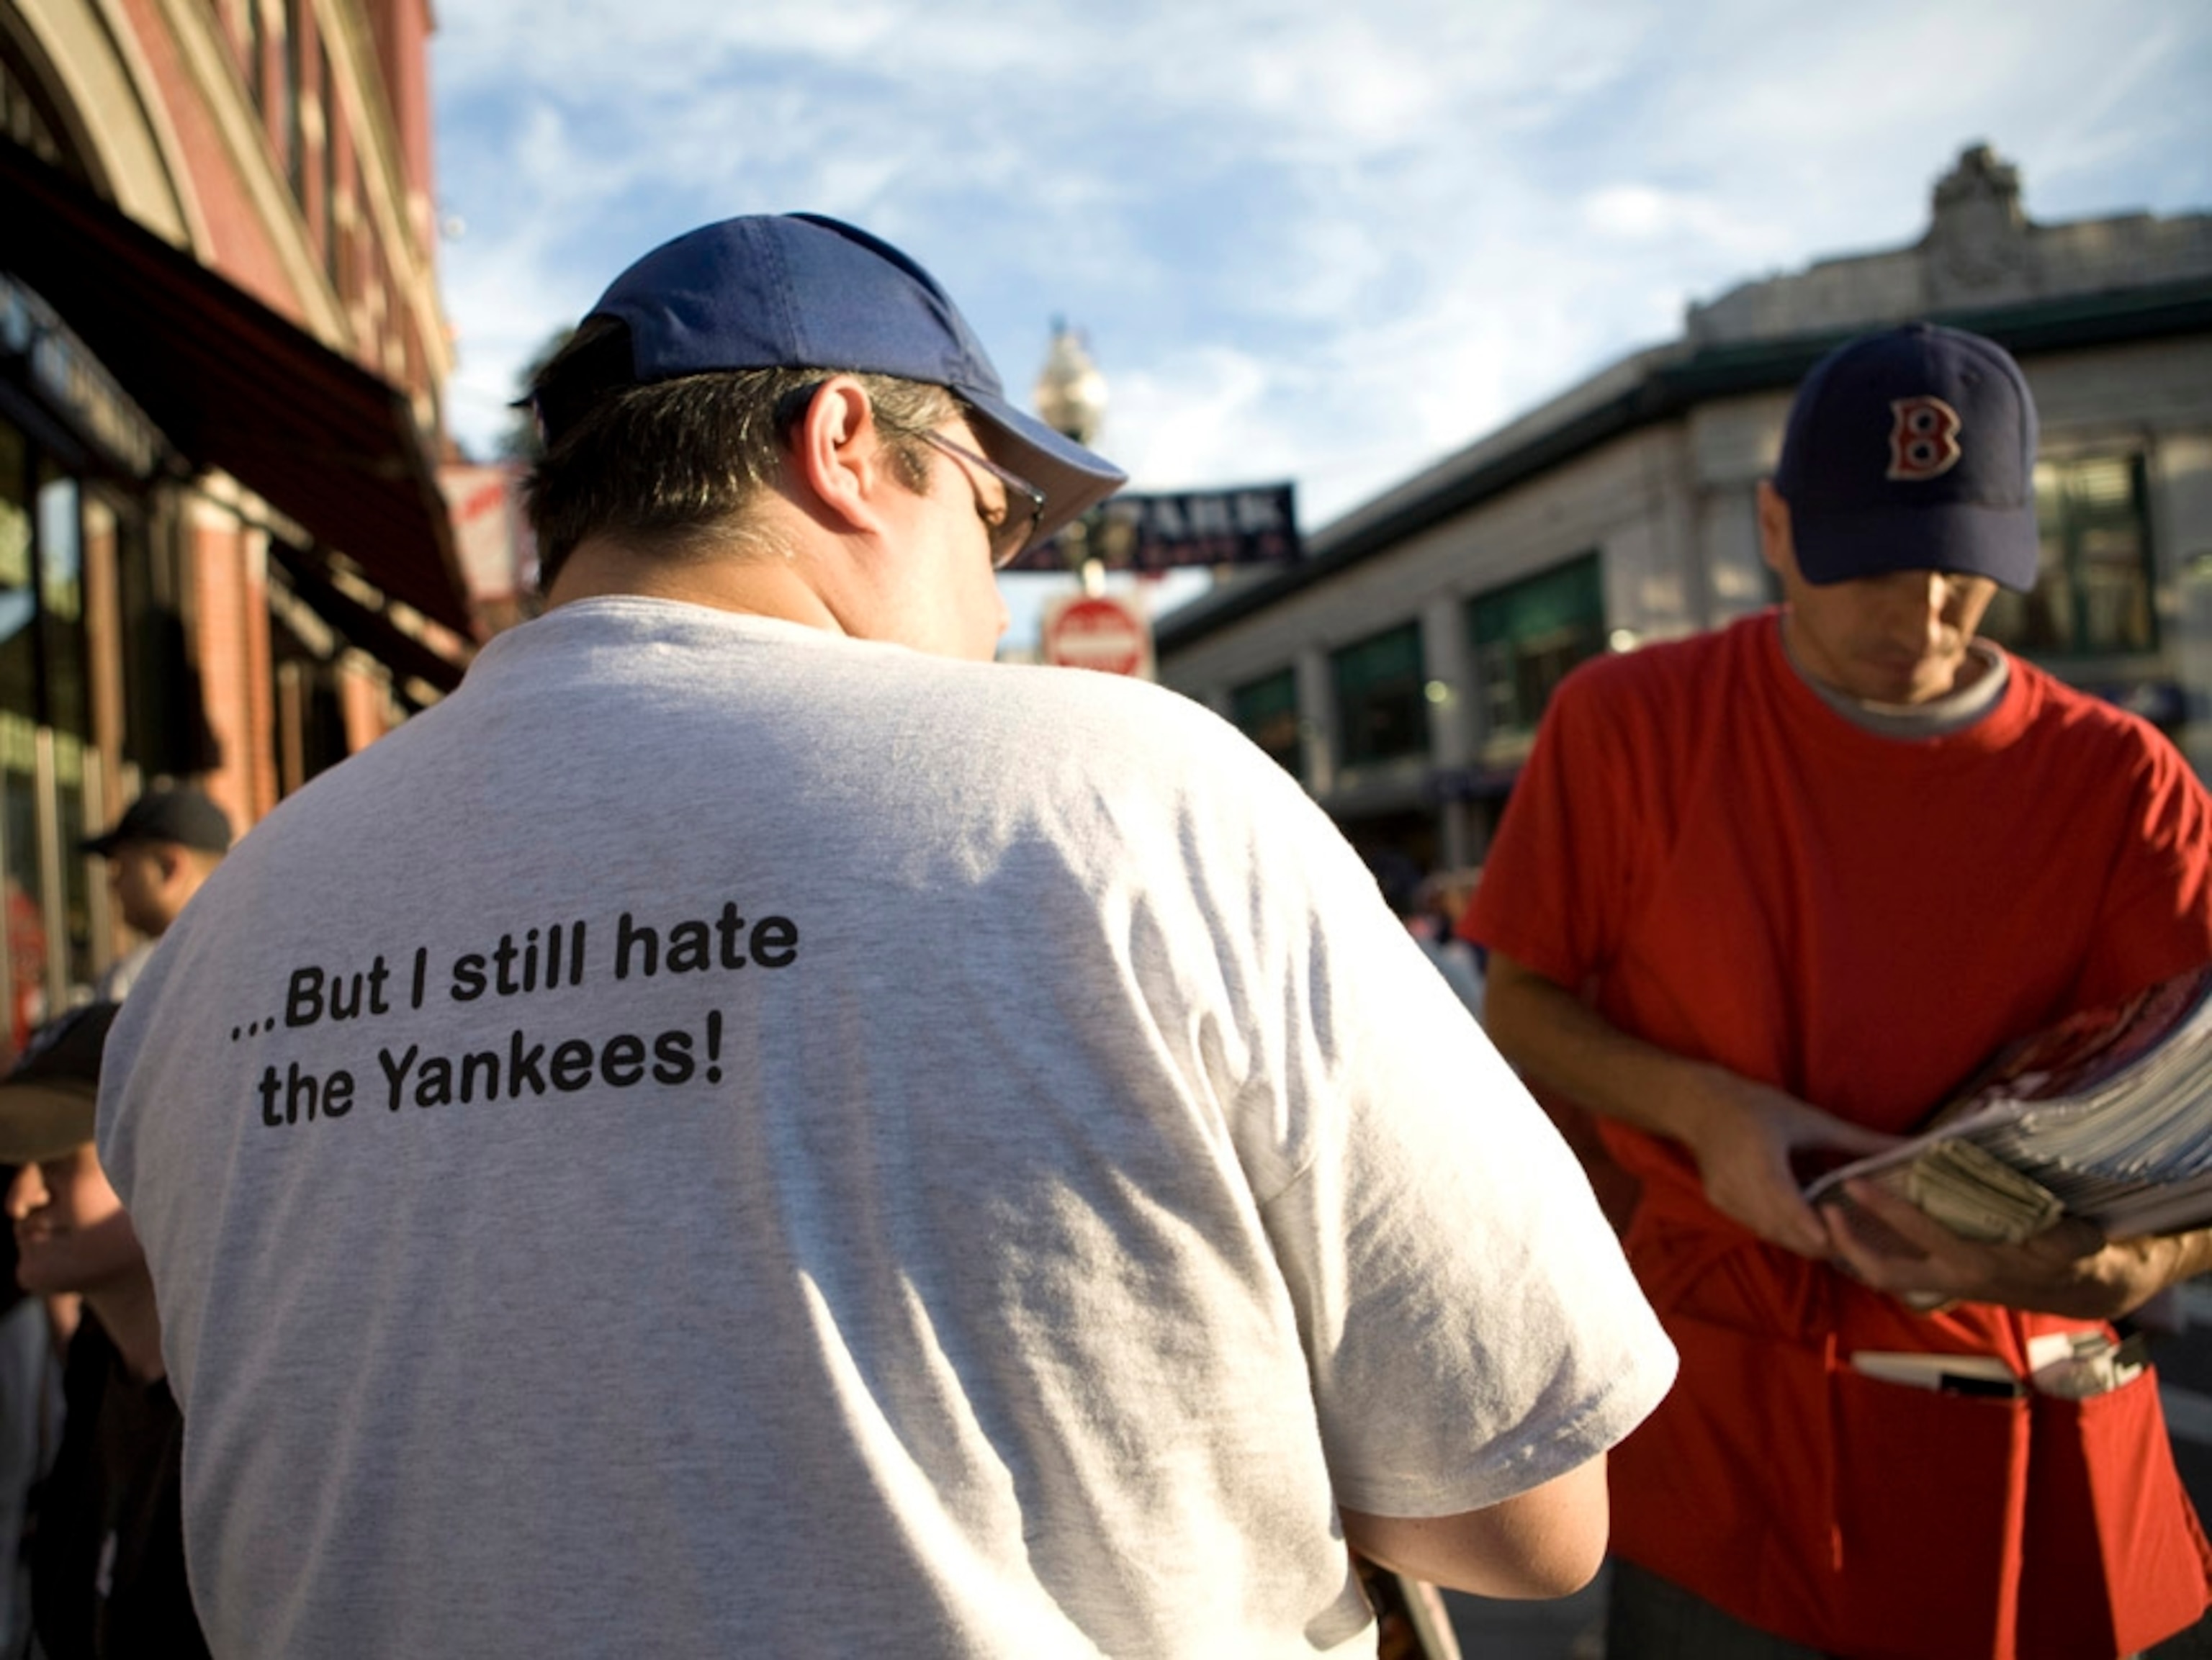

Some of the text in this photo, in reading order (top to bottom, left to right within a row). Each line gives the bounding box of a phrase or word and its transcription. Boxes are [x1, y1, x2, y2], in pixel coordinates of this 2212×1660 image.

[1886, 396, 1962, 482] B
[230, 900, 799, 1042] ...But I still hate
[257, 1009, 723, 1128] the Yankees!
